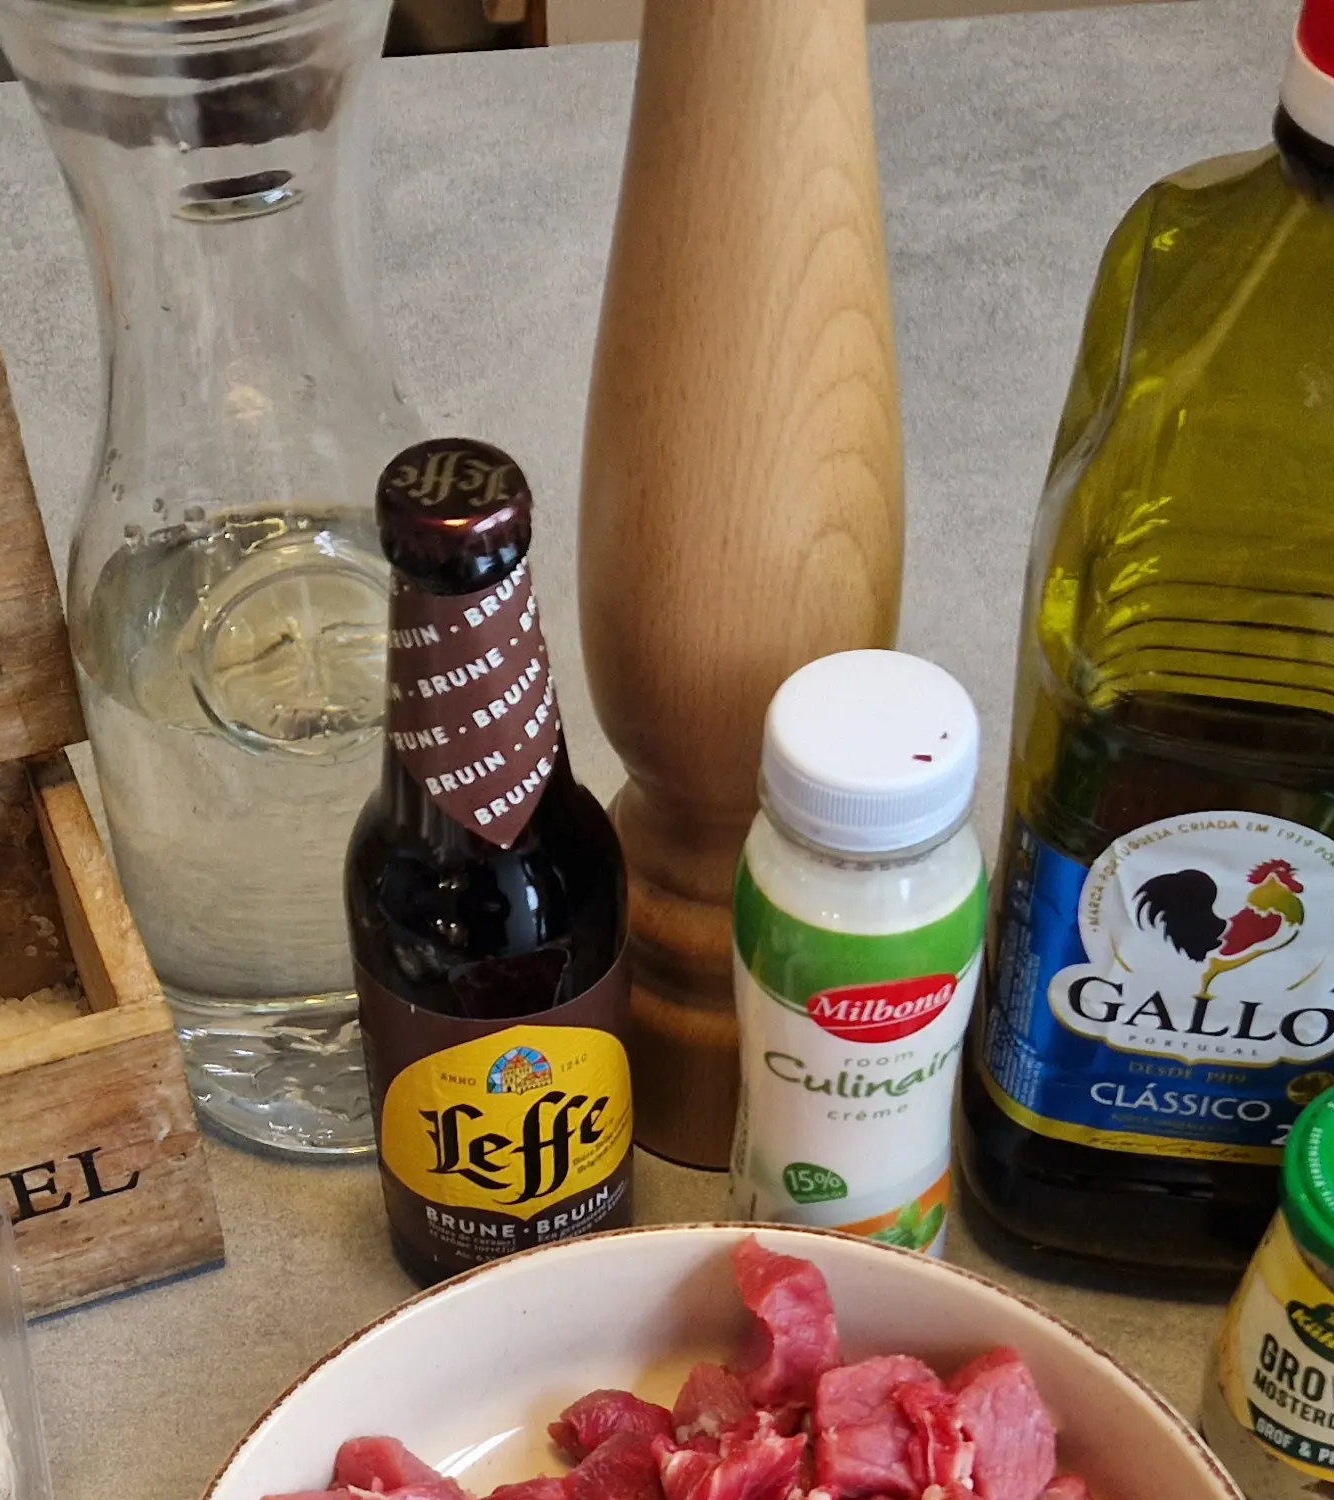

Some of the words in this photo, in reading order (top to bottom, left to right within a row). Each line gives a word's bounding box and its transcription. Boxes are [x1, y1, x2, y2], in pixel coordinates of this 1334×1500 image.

[417, 647, 505, 699] BRUNE
[472, 657, 542, 730] BRUIN
[425, 750, 507, 796] BRUIN
[474, 756, 552, 826] BRUNE
[813, 981, 954, 1023] Milbona
[843, 1051, 916, 1069] room
[1128, 1035, 1260, 1057] PORTUGAL
[440, 1072, 477, 1087] ANNO
[1089, 1082, 1272, 1123] CLÁSSICO
[418, 1091, 611, 1206] Leffe
[786, 1167, 842, 1193] 15%
[425, 1205, 516, 1239] BRUNE
[536, 1184, 609, 1235] BRUIN
[1255, 1416, 1295, 1449] GROF
[1298, 1440, 1312, 1459] &
